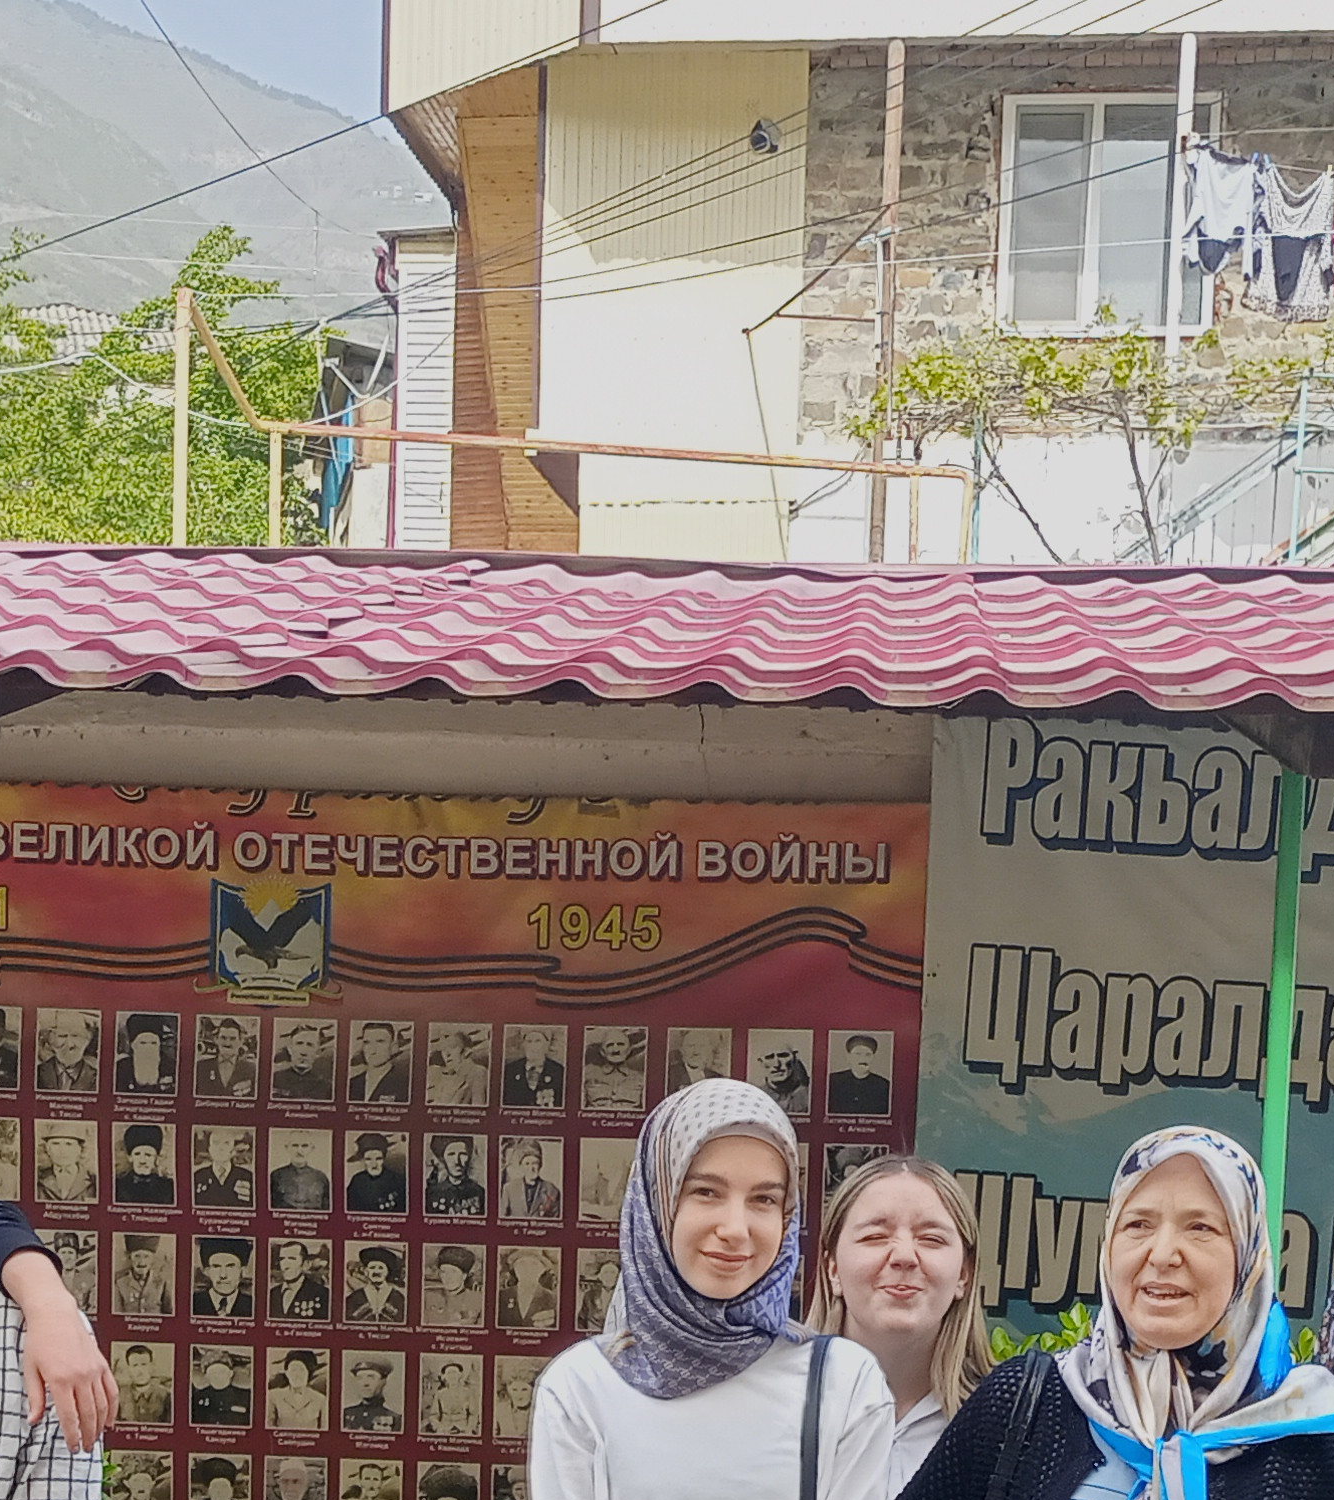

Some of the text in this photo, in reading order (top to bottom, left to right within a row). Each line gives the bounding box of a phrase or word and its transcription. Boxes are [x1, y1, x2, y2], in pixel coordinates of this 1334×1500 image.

[232, 830, 683, 880] ОТЕЧЕСТВЕННОЙ
[695, 833, 892, 883] ВОЙНЫ
[526, 904, 664, 951] 1945
